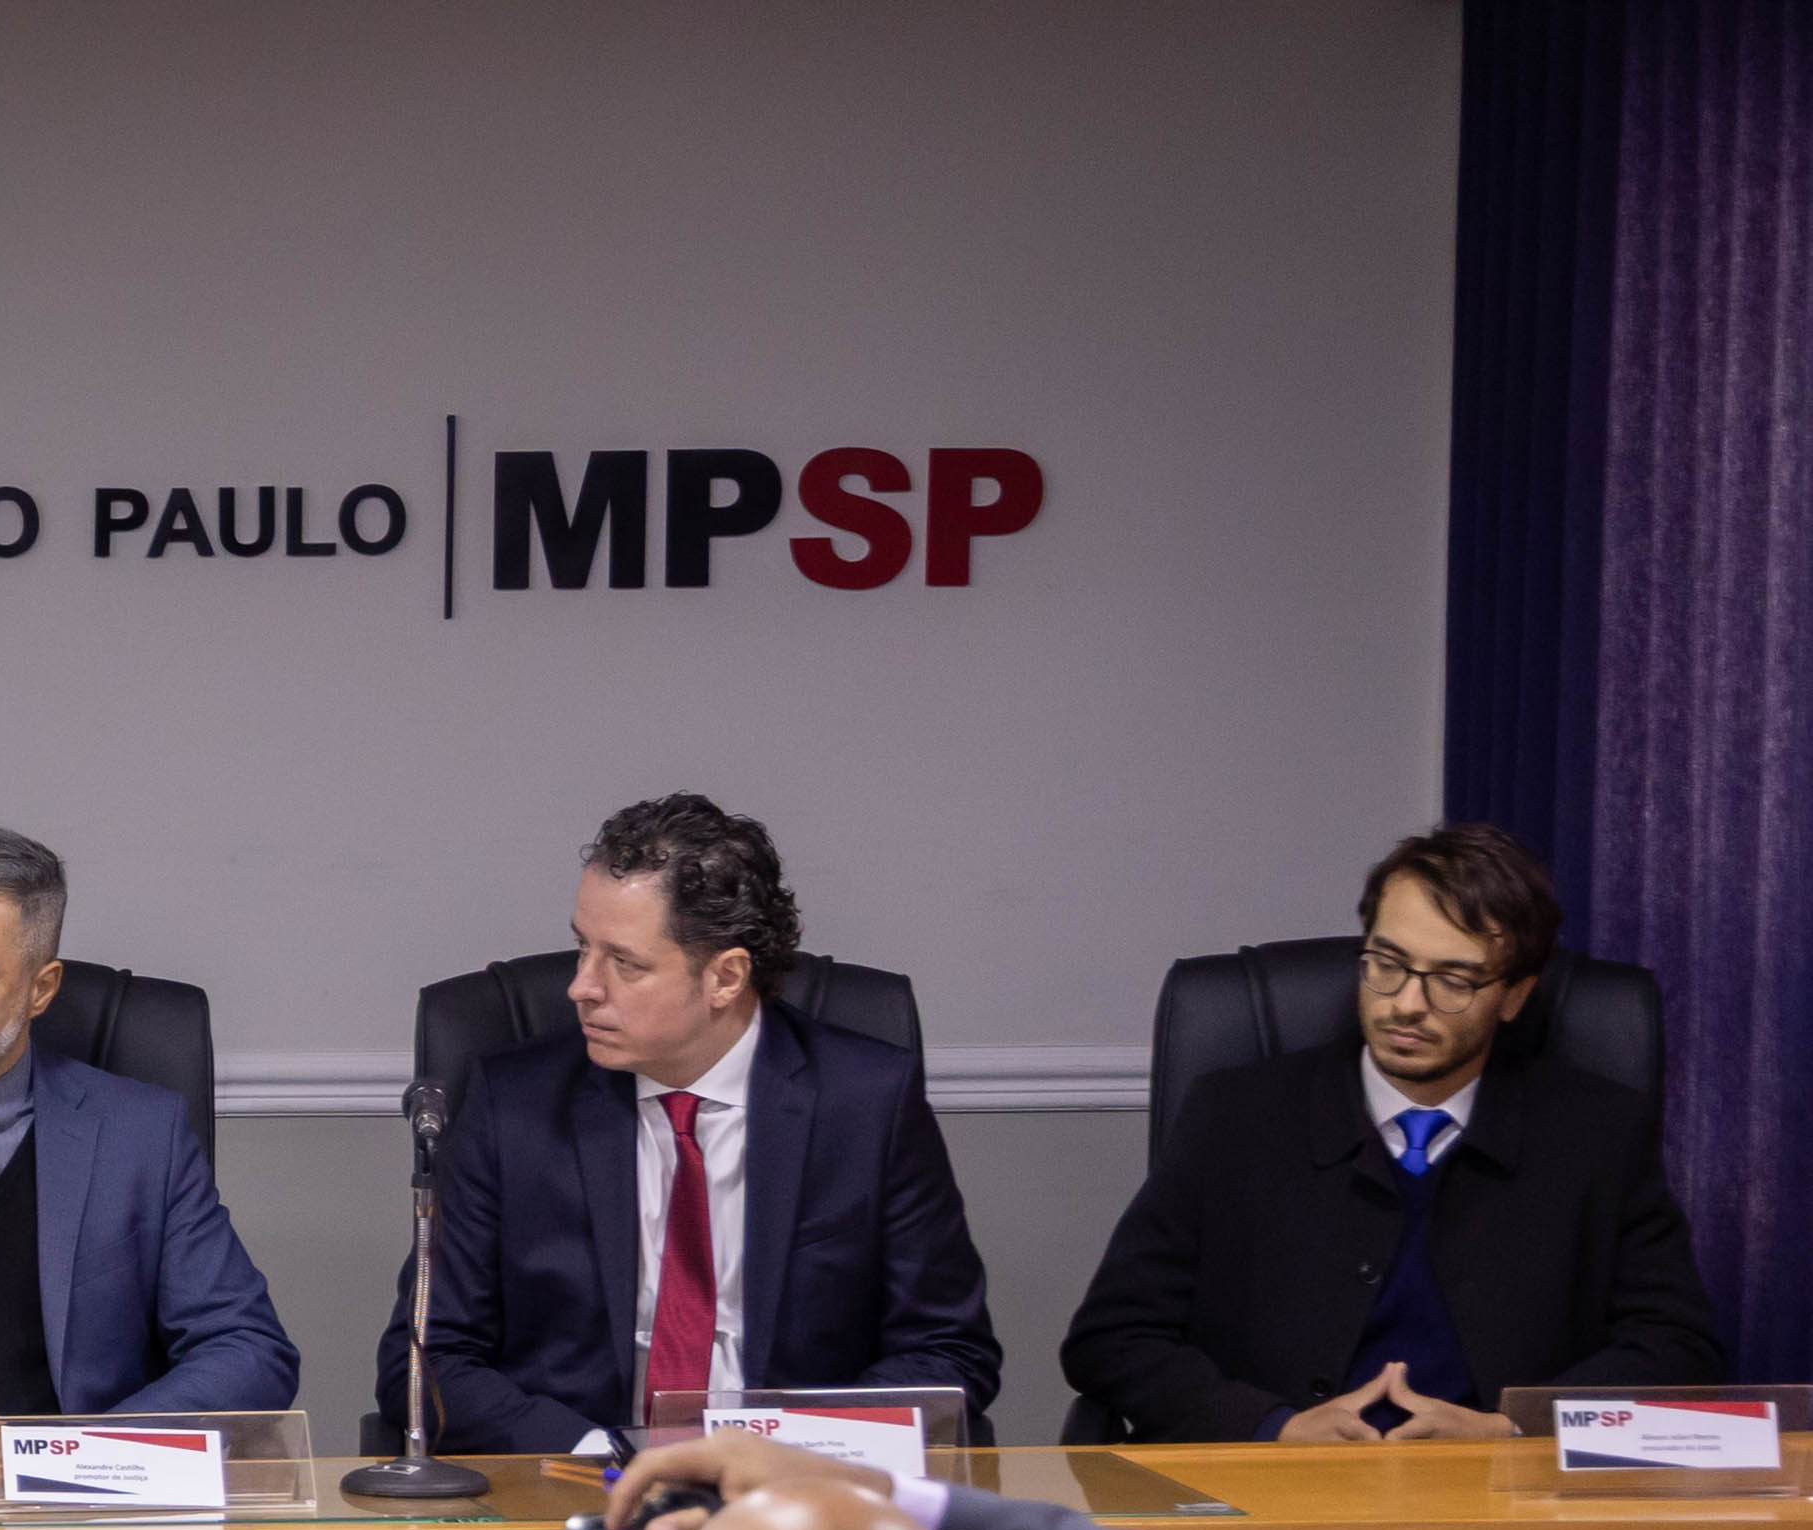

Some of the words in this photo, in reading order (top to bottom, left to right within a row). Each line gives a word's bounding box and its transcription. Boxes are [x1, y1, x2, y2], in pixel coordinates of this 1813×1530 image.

[93, 484, 407, 560] PAULO
[493, 446, 1044, 591] MPSP
[1562, 1411, 1632, 1427] MPSP
[13, 1439, 80, 1455] MPSP
